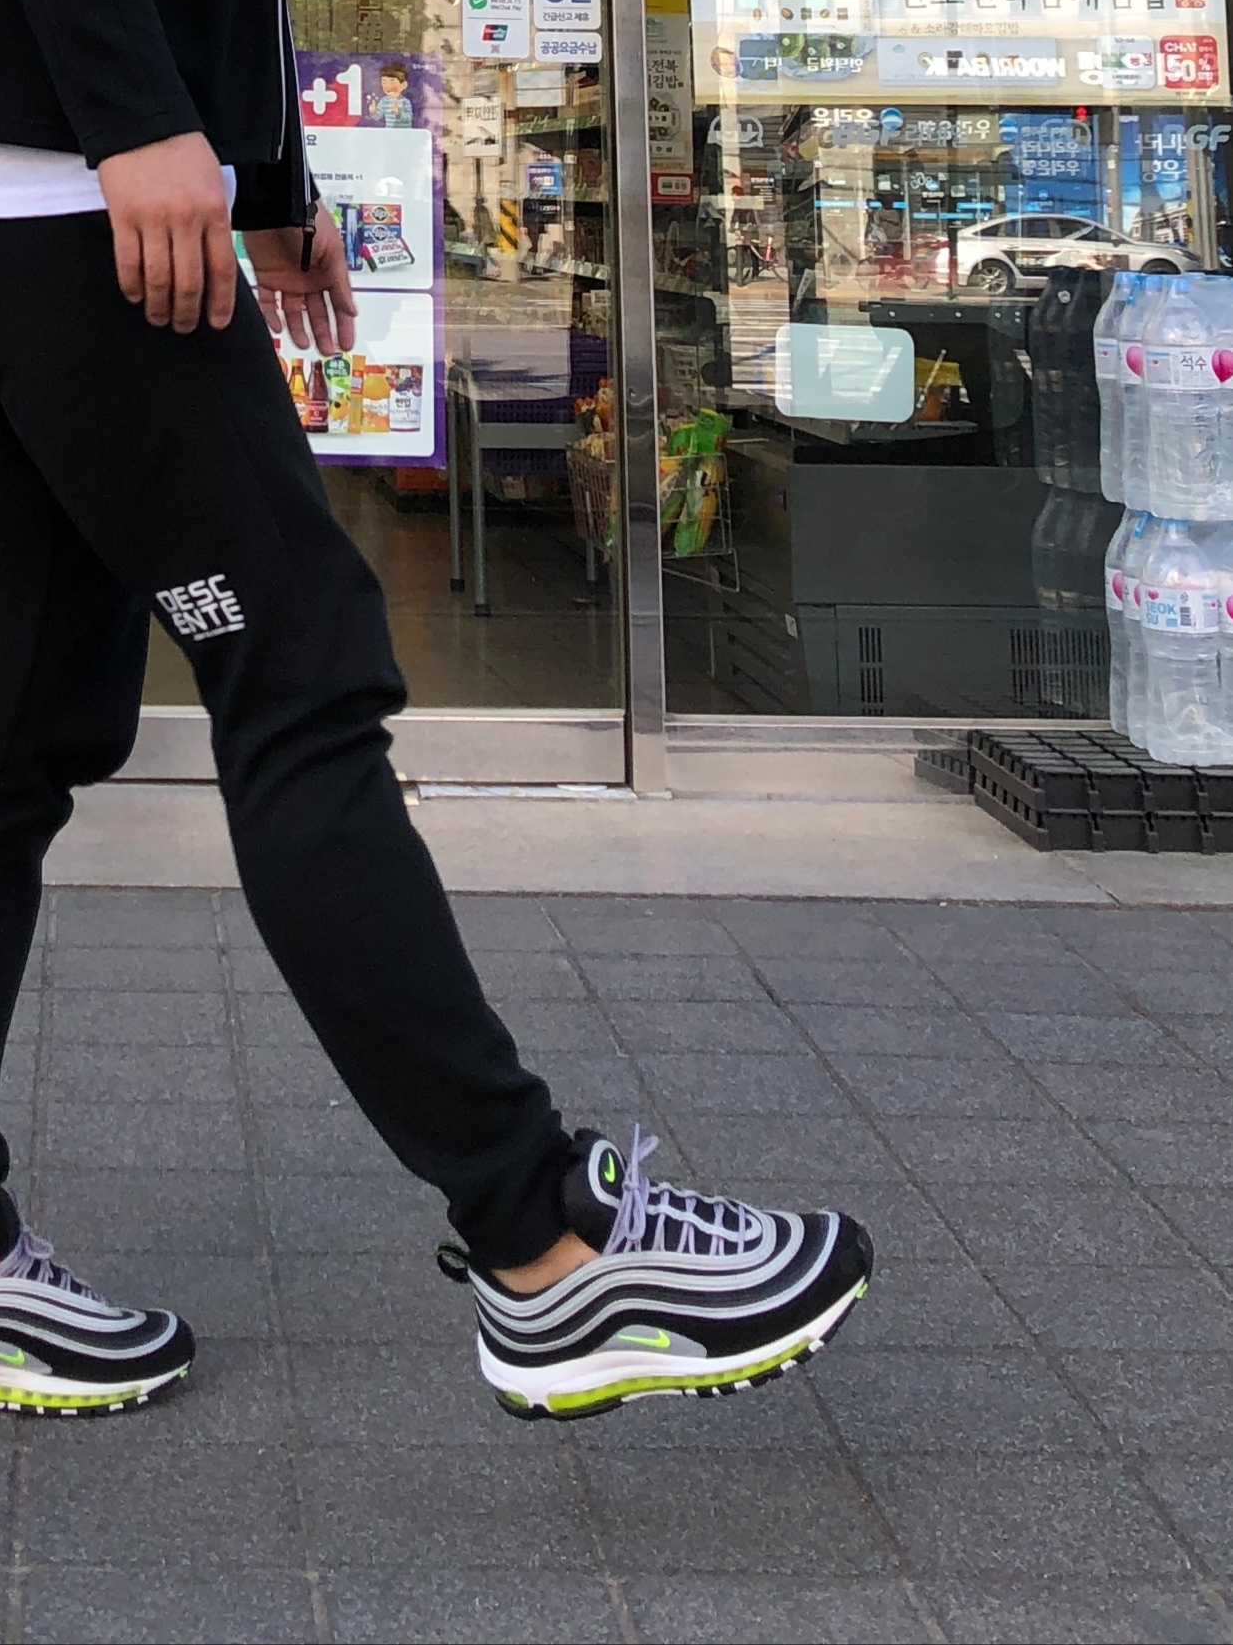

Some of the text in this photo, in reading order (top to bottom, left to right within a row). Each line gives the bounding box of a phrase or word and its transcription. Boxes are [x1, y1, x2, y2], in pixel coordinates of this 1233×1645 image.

[543, 12, 573, 22] 긴급신고
[540, 42, 597, 55] 공공요금수납
[303, 63, 363, 116] +1
[1181, 354, 1207, 372] 석수
[155, 574, 234, 613] DESC
[1145, 602, 1177, 614] SEOK
[171, 597, 245, 635] ENTE
[1145, 613, 1159, 626] SU
